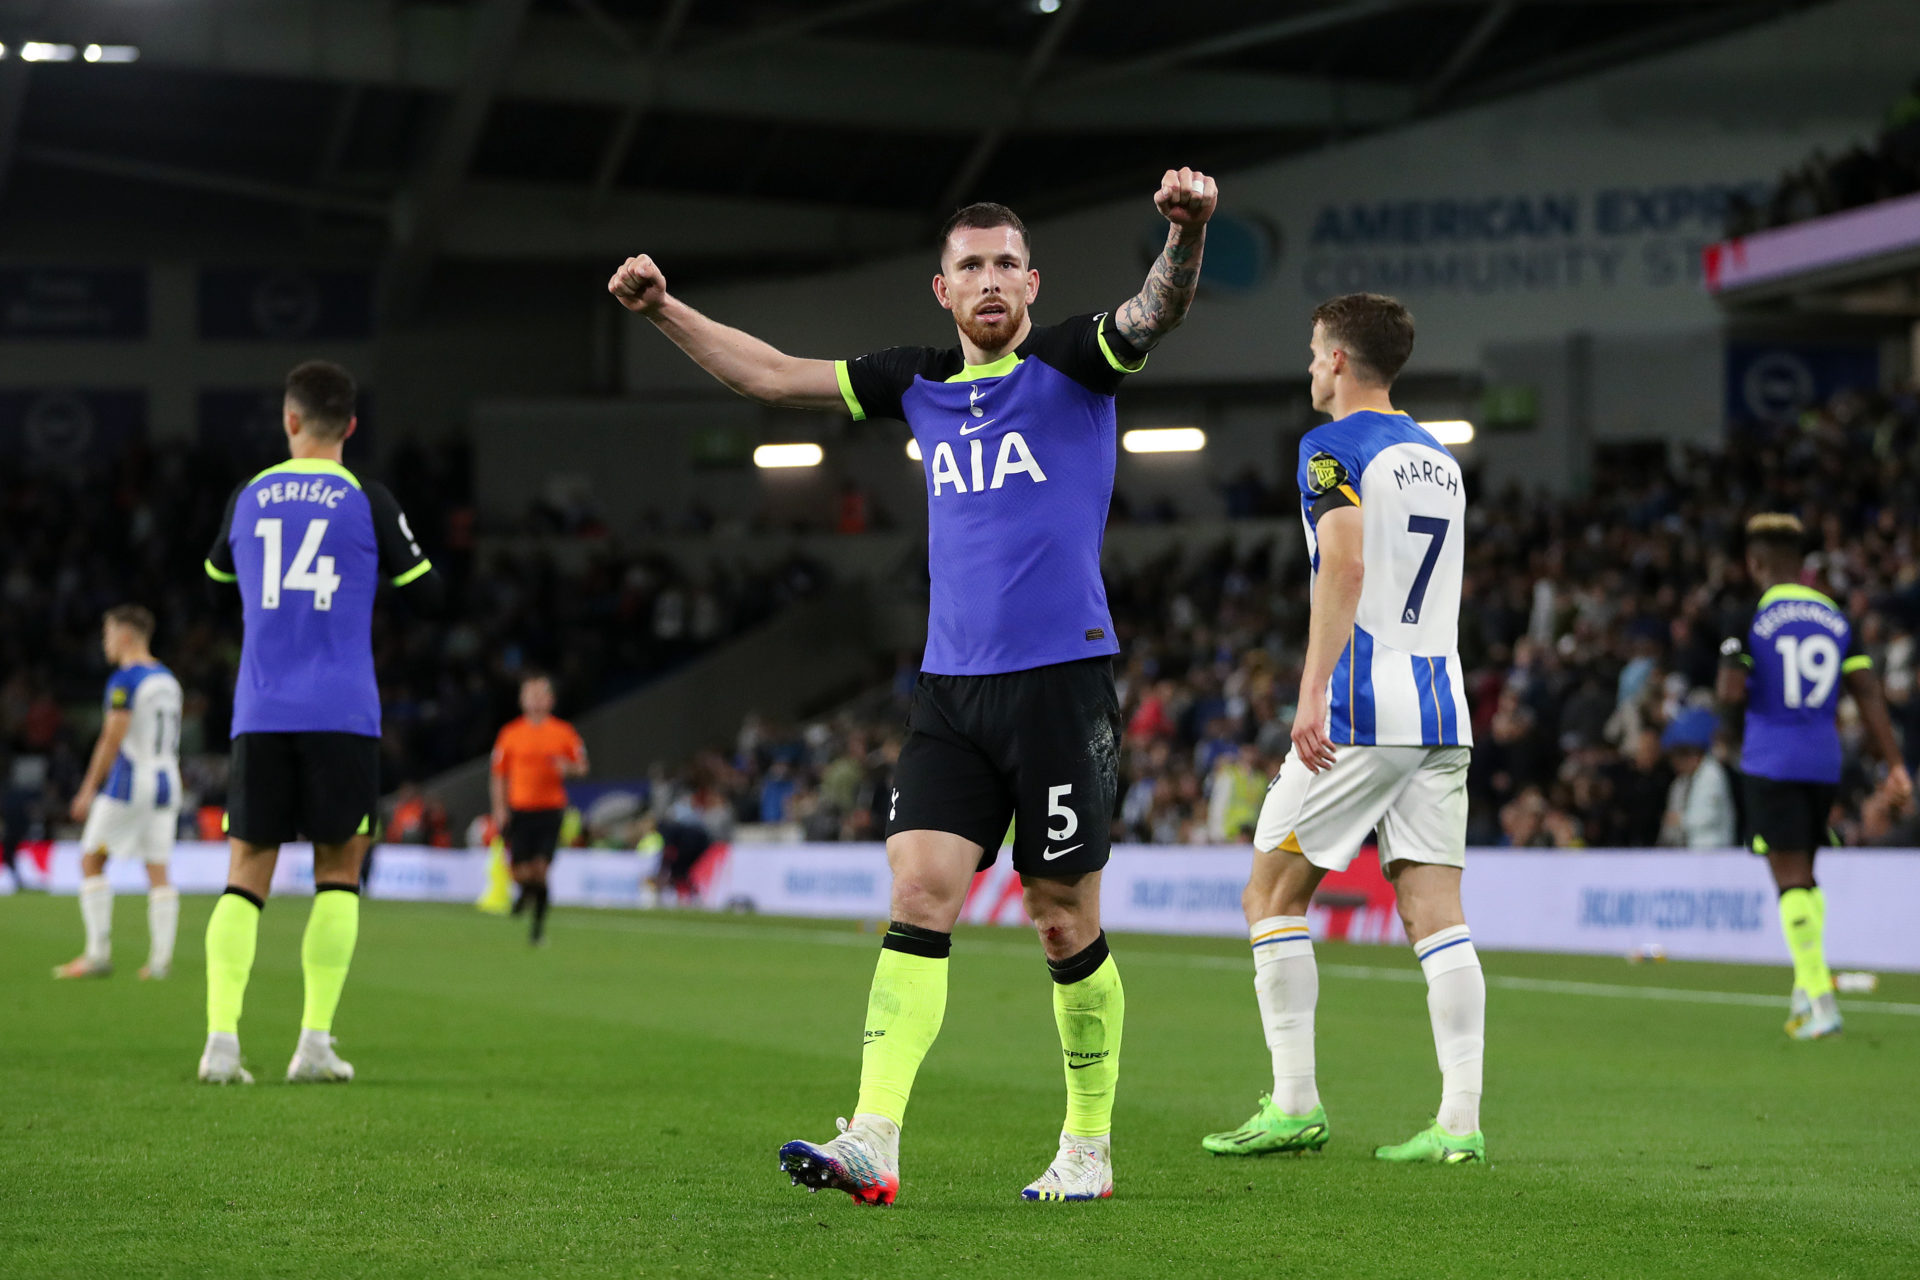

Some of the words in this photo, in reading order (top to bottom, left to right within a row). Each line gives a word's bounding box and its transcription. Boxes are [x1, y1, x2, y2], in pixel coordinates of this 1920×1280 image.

[1311, 195, 1577, 241] AMERICAN
[932, 431, 1047, 496] AIA
[1393, 461, 1458, 496] MARCH
[254, 518, 341, 611] 14
[1401, 515, 1450, 624] 7
[1775, 633, 1840, 709] 19
[1048, 784, 1078, 841] 5
[1064, 1049, 1110, 1059] SPURS
